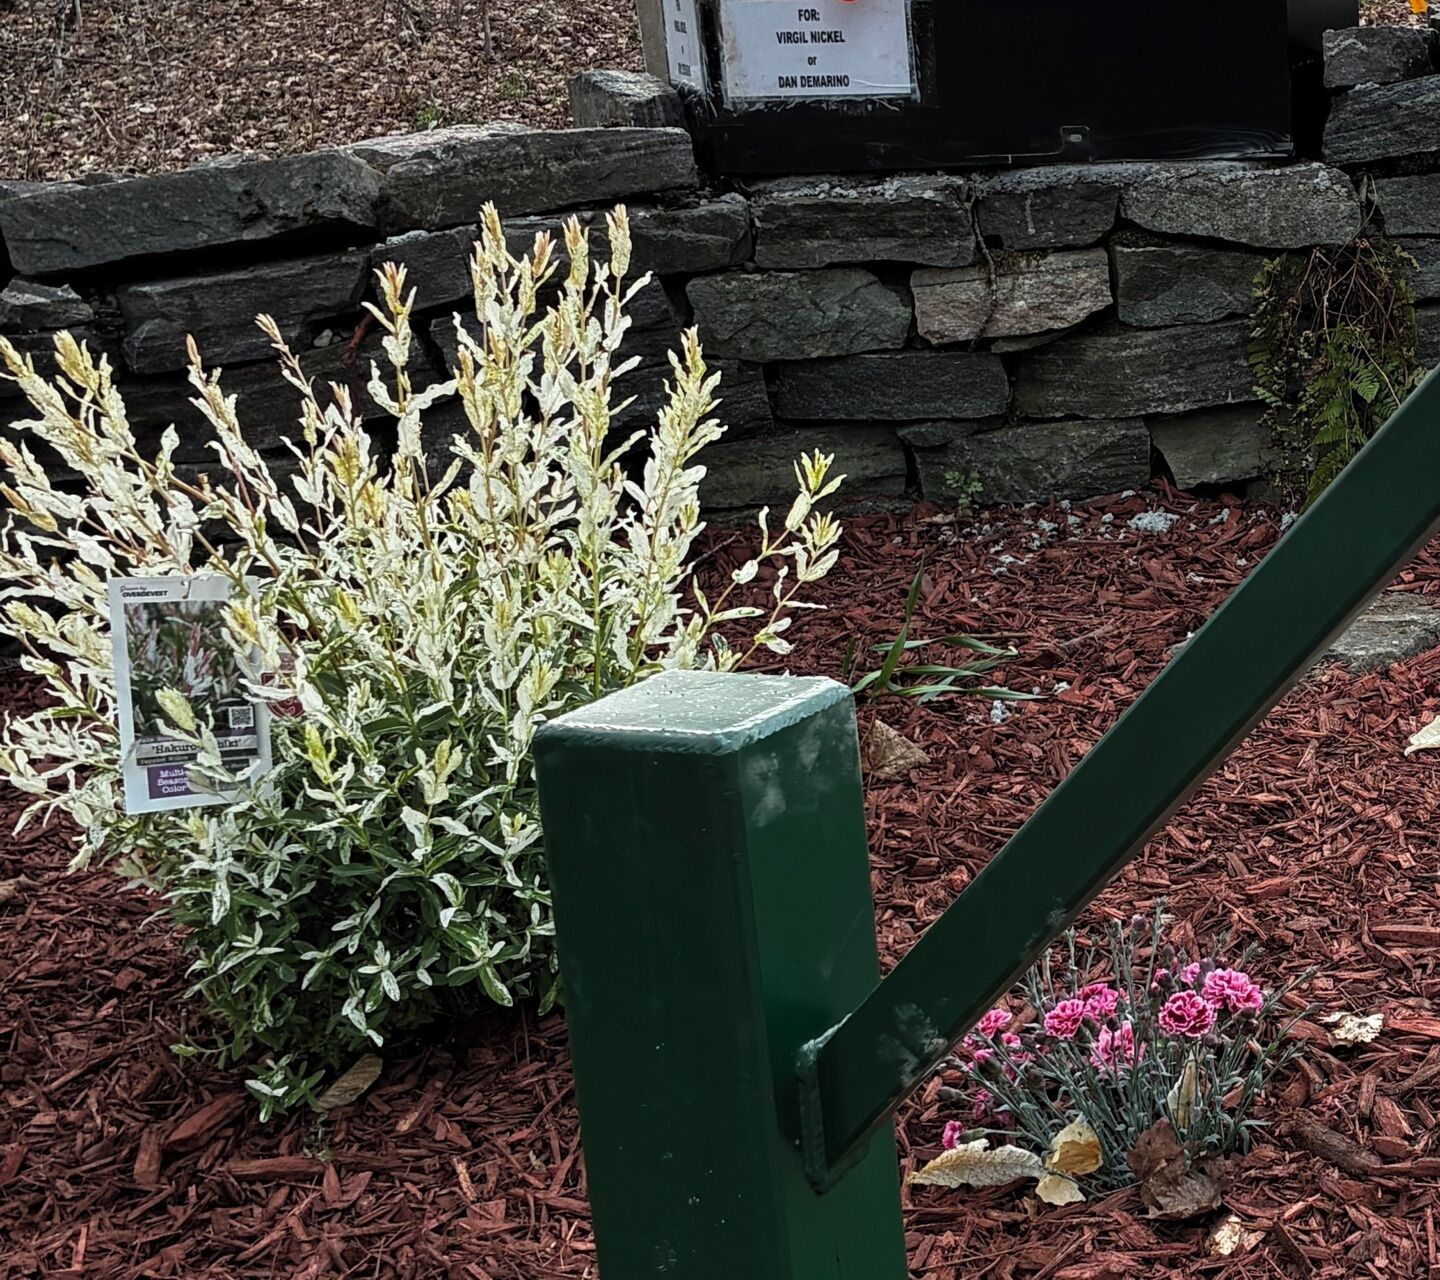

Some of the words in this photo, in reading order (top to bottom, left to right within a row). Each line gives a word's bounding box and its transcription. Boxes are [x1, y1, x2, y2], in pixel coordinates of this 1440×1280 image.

[798, 8, 820, 22] FOR:
[776, 31, 809, 45] VIRGIL
[810, 30, 846, 44] NICKEL
[807, 56, 817, 66] or
[778, 75, 798, 89] DAN
[800, 74, 850, 88] DEMARINO
[162, 785, 187, 794] Color
